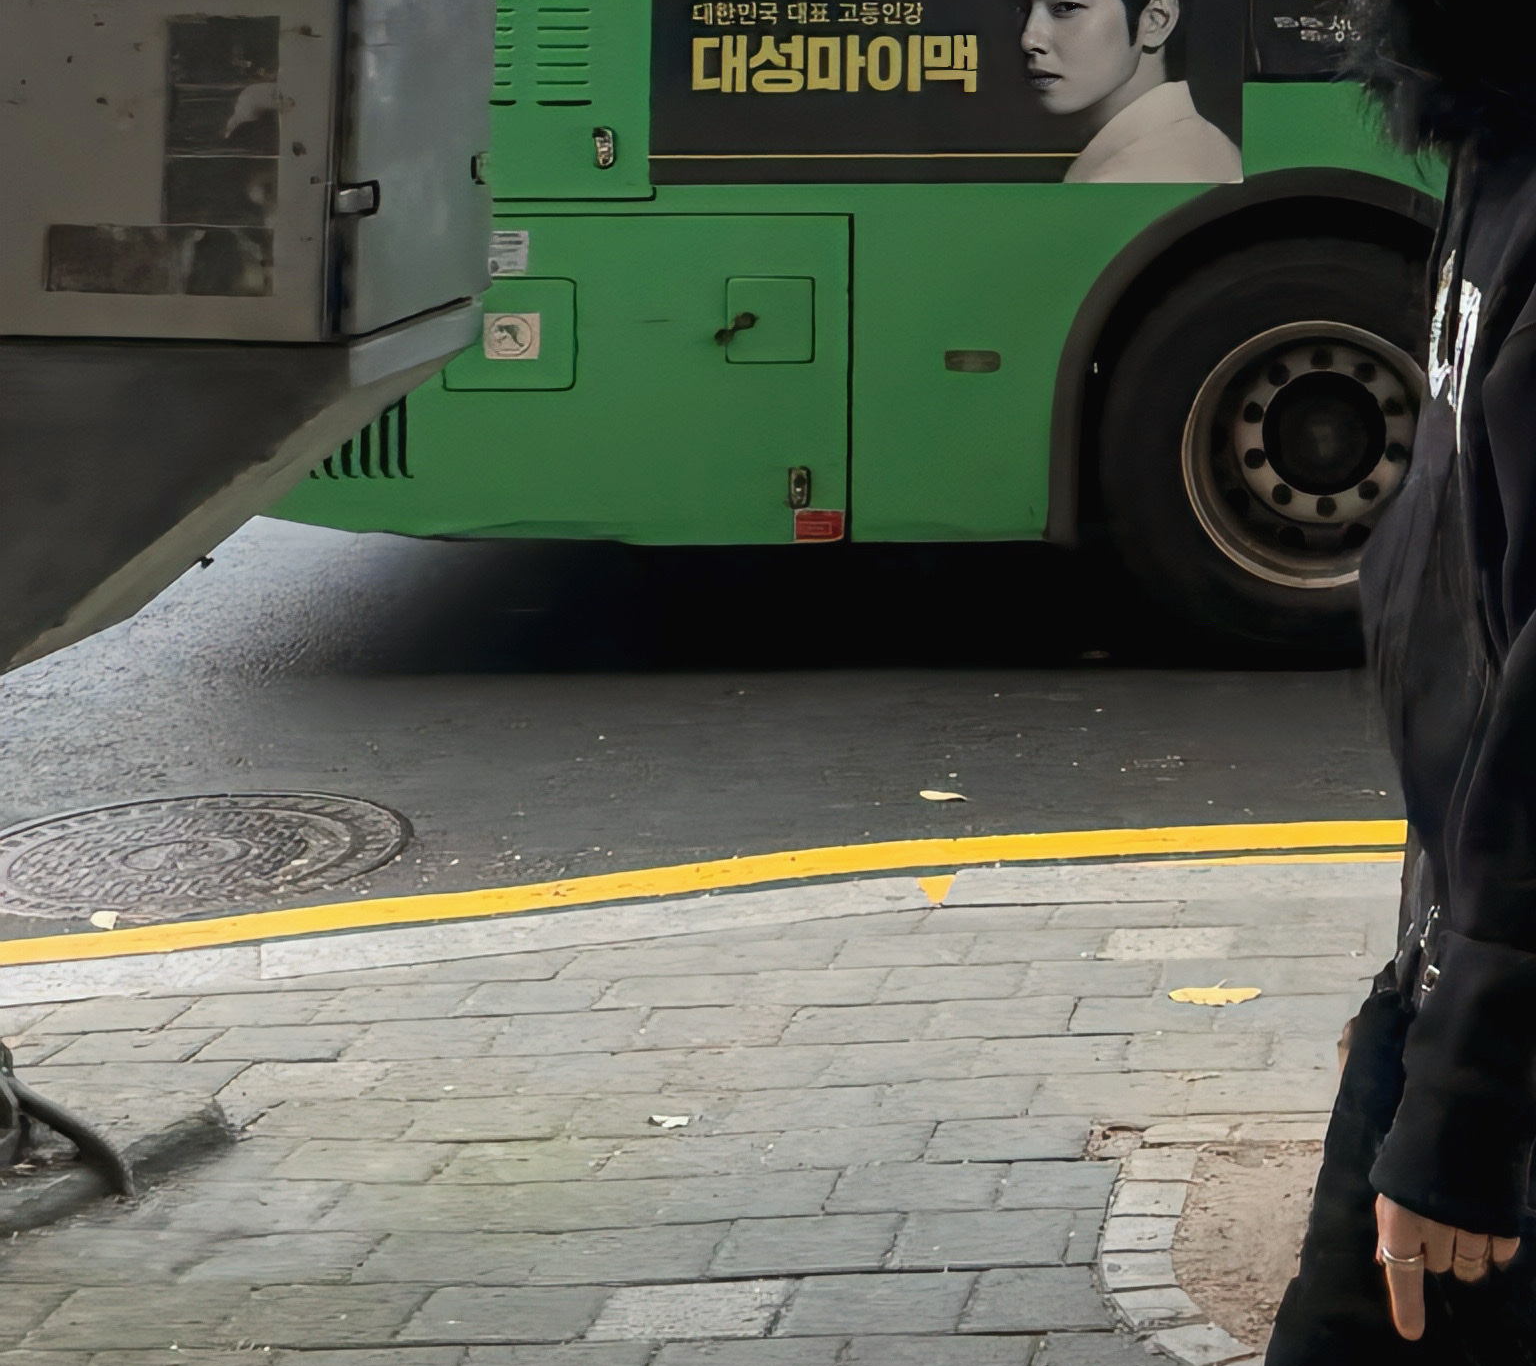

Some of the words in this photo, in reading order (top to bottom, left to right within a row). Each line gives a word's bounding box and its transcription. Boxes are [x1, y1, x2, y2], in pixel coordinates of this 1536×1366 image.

[692, 1, 779, 26] 대한민국
[787, 1, 831, 25] 대표
[838, 1, 924, 26] 고등인강
[691, 34, 978, 94] 대성마이맥
